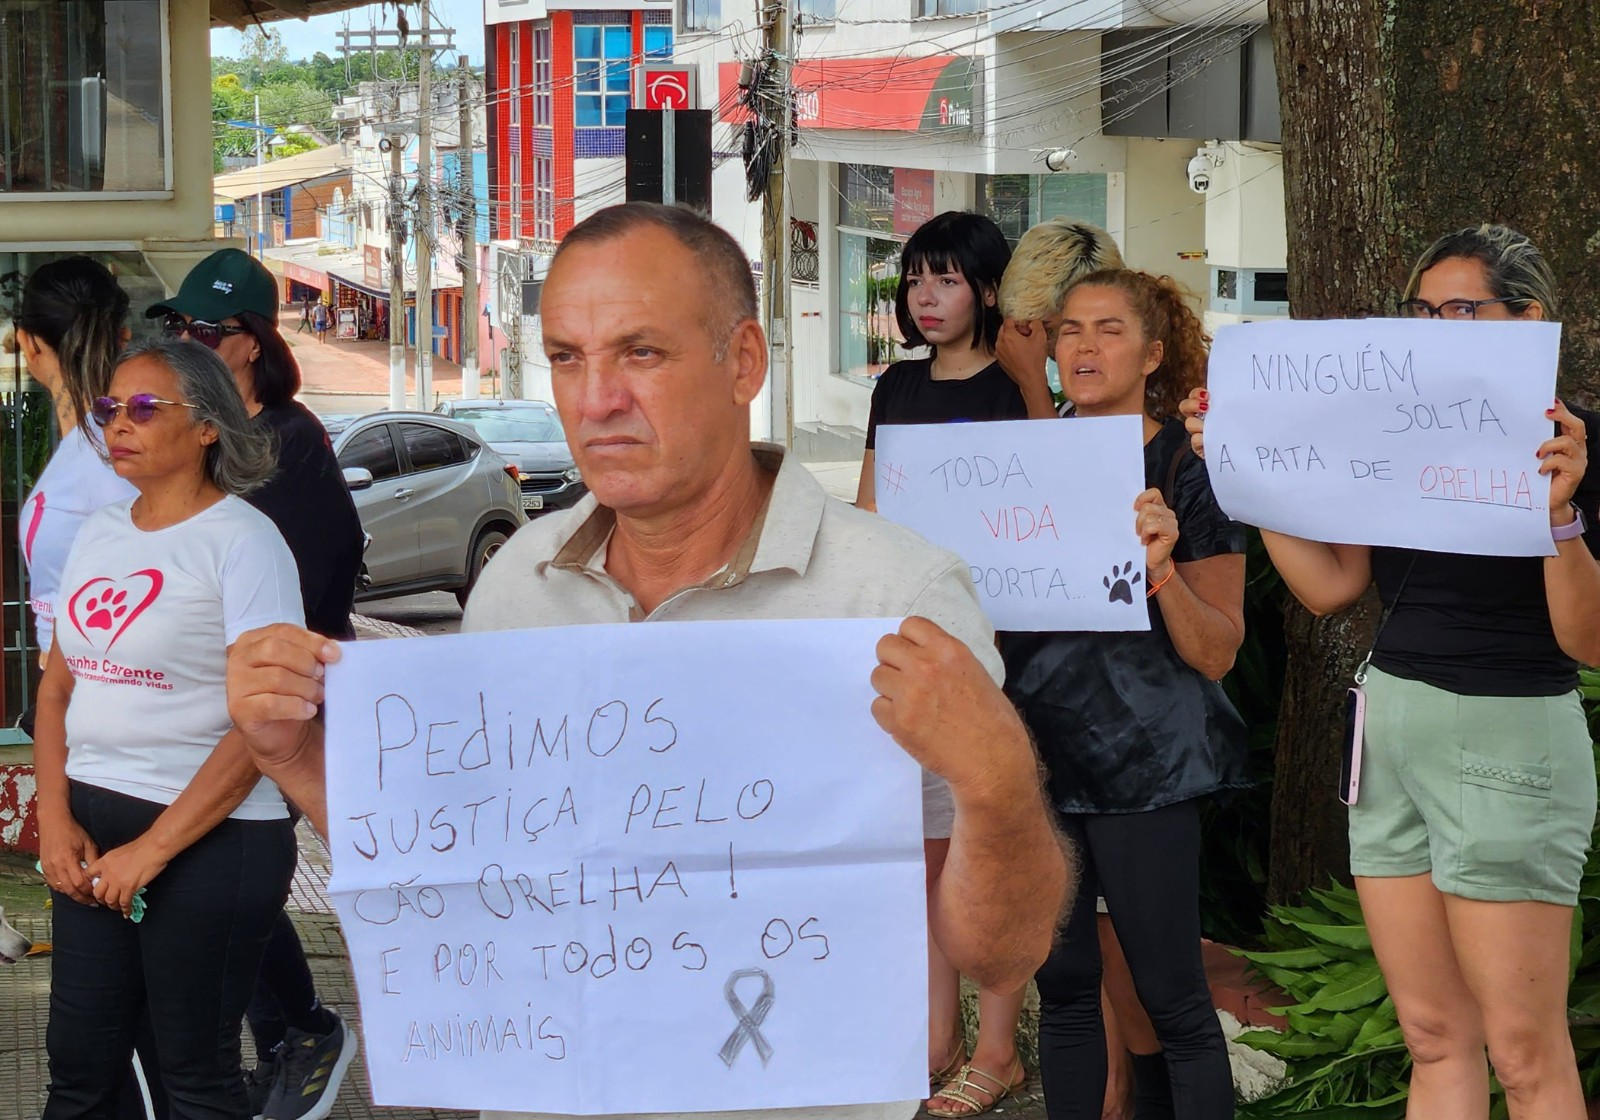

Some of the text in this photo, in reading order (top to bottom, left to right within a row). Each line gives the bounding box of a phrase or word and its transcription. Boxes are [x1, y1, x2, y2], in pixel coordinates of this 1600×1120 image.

[948, 101, 971, 125] Prime
[1252, 343, 1419, 395] NINGUÉM
[1383, 399, 1507, 436] SOLTA
[930, 453, 1033, 493] TODA
[1219, 444, 1236, 472] A
[1256, 445, 1326, 472] PATA
[1350, 460, 1394, 480] DE
[980, 504, 1059, 542] VIDA
[969, 565, 1086, 600] PORTA...
[84, 672, 143, 686] transformando
[146, 681, 174, 690] vidas
[102, 659, 165, 681] Carente
[625, 778, 774, 833] PELO
[354, 874, 445, 924] CÃO
[382, 947, 401, 994] E
[434, 941, 503, 987] POR
[761, 917, 830, 960] OS
